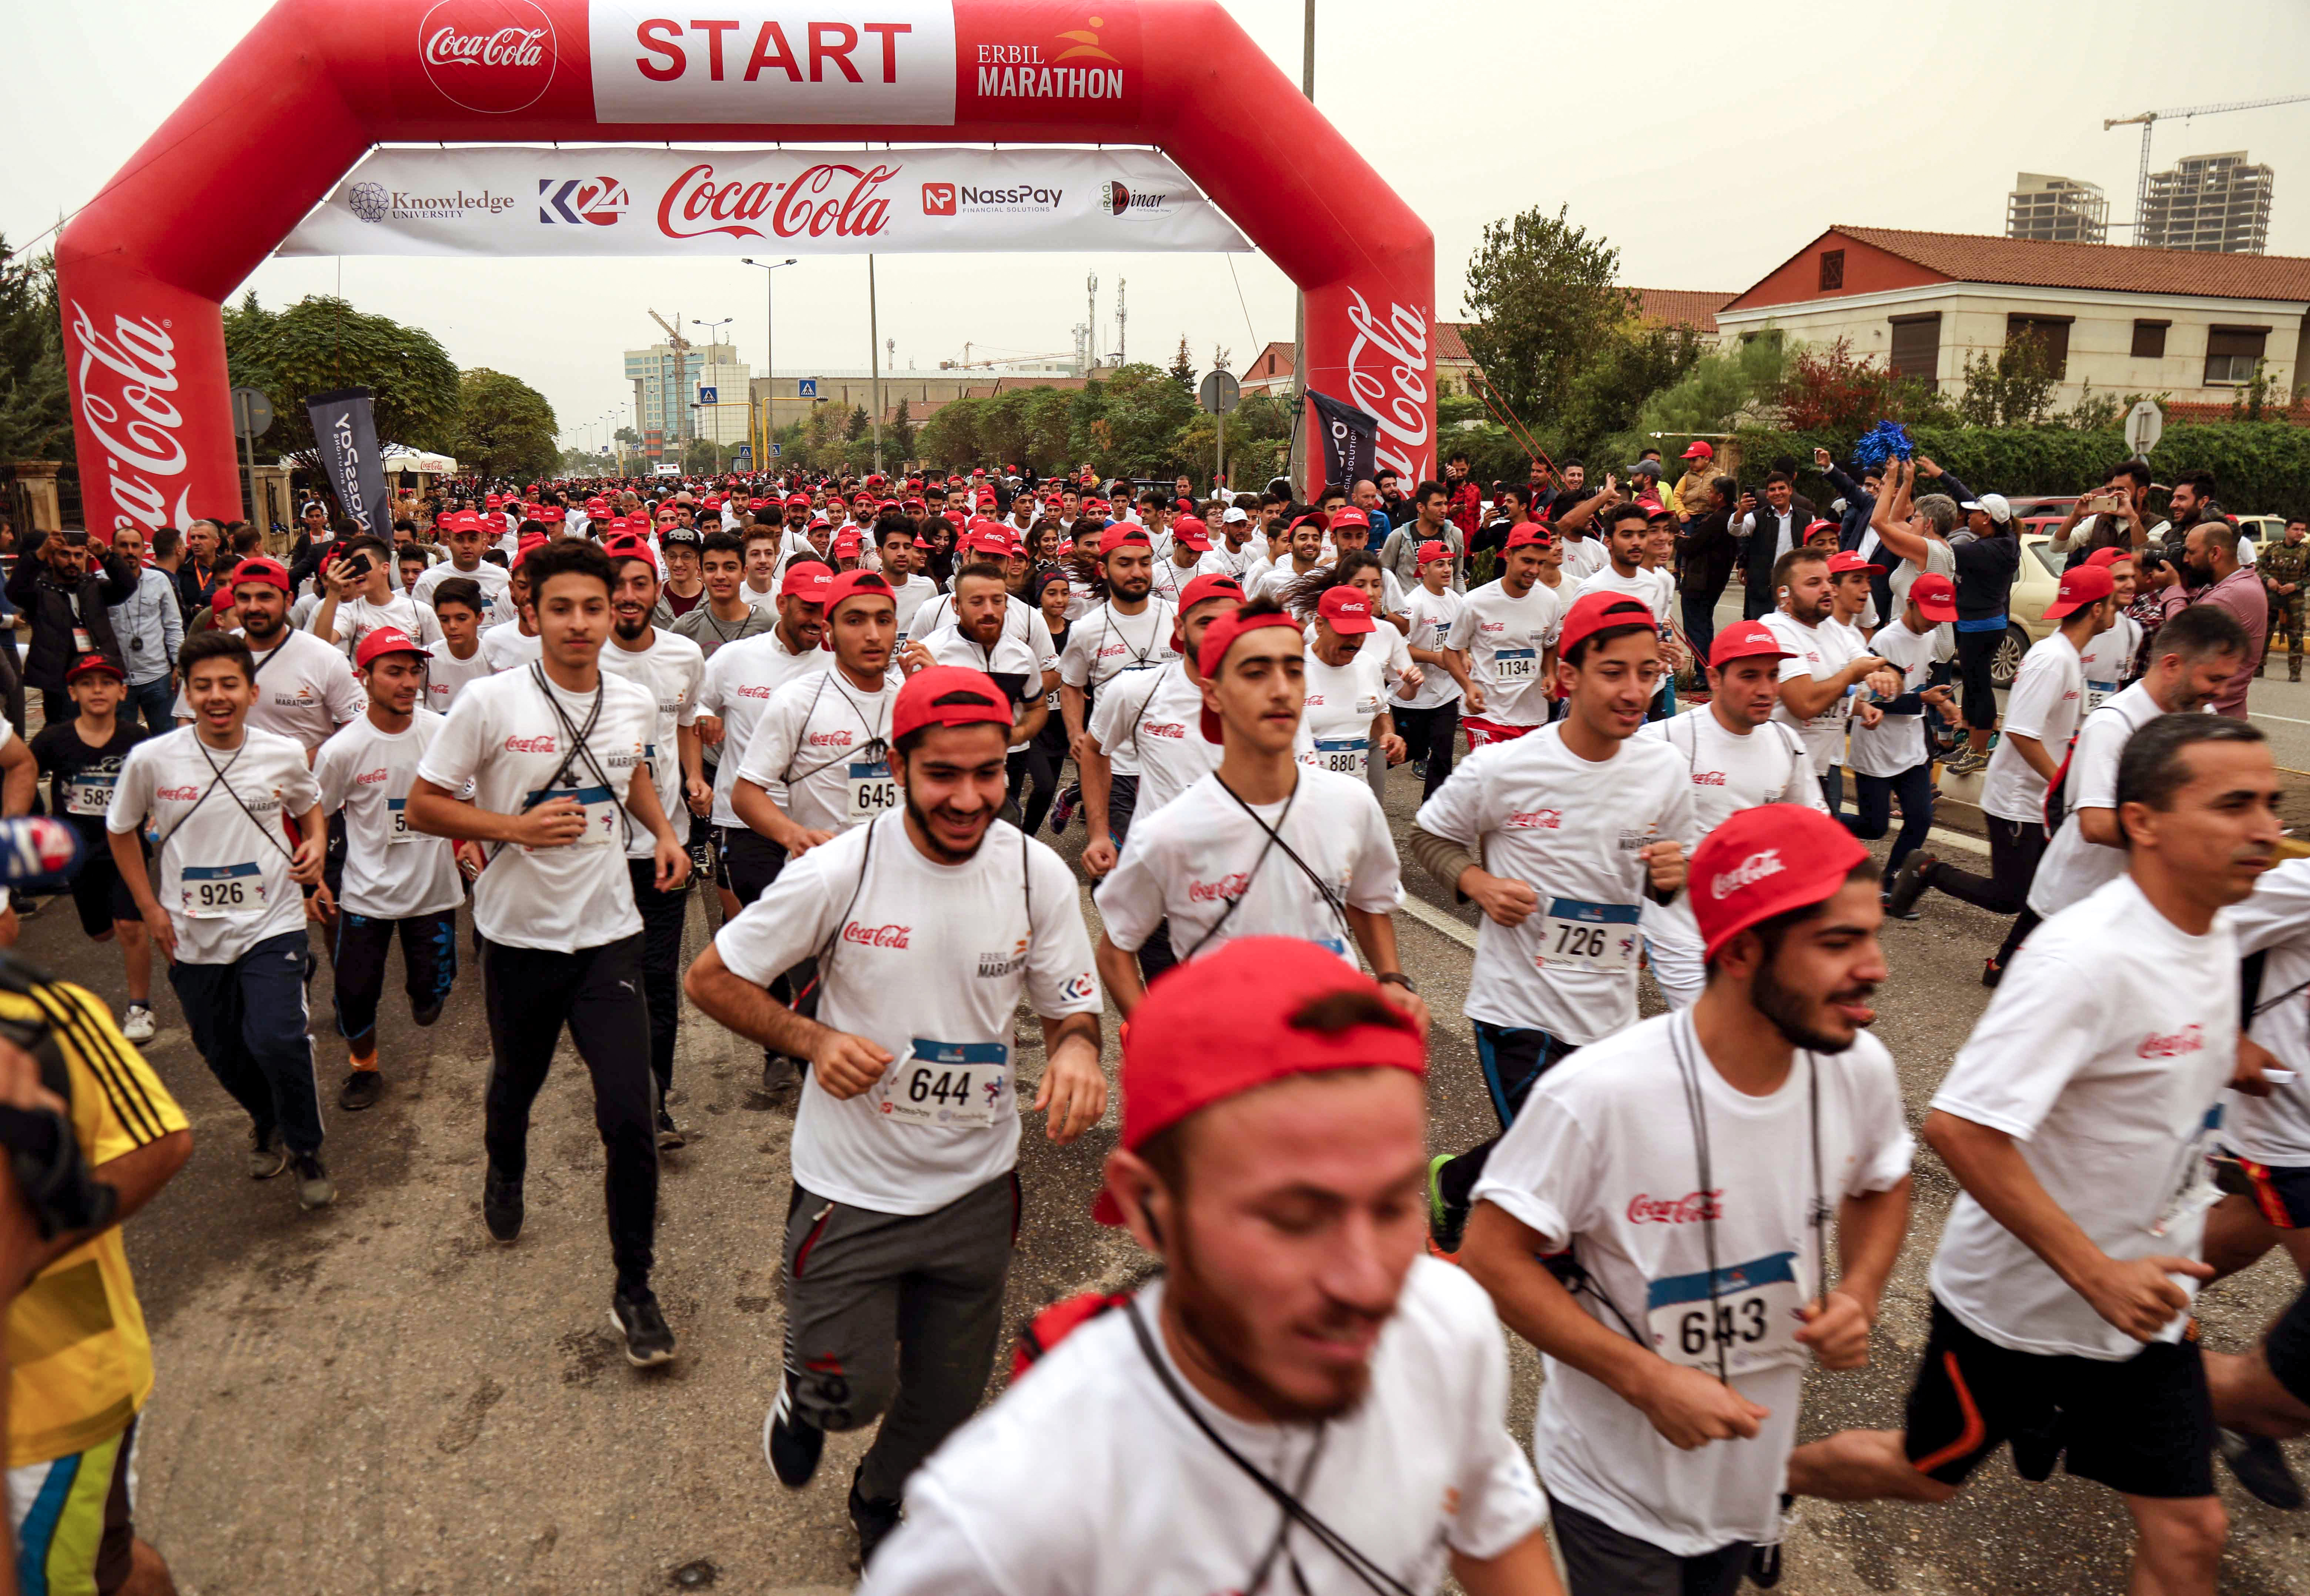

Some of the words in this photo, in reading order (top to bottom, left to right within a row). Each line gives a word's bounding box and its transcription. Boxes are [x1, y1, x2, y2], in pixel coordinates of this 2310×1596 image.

[427, 26, 549, 66] Coca-Cola
[636, 18, 913, 83] START
[977, 45, 1045, 65] ERBIL
[977, 66, 1124, 99] MARATHON
[391, 190, 515, 214] Knowledge
[657, 163, 903, 240] Coca-Cola
[961, 185, 1063, 208] NassPay
[1102, 185, 1112, 211] IRAQ
[1114, 187, 1166, 208] Dinar
[392, 209, 464, 219] UNIVERSITY
[1346, 285, 1428, 506] a-Cola
[71, 299, 192, 548] a-Cola
[1347, 429, 1357, 472] SOLUTION
[814, 575, 833, 584] Coca-C
[1497, 660, 1530, 676] 1134
[1330, 754, 1355, 772] 880
[83, 788, 114, 806] 583
[858, 783, 895, 809] 645
[200, 882, 244, 906] 926
[844, 921, 913, 950] Coca-Cola
[1554, 924, 1607, 958] 726
[909, 1069, 972, 1106] 644
[1680, 1297, 1768, 1355] 643
